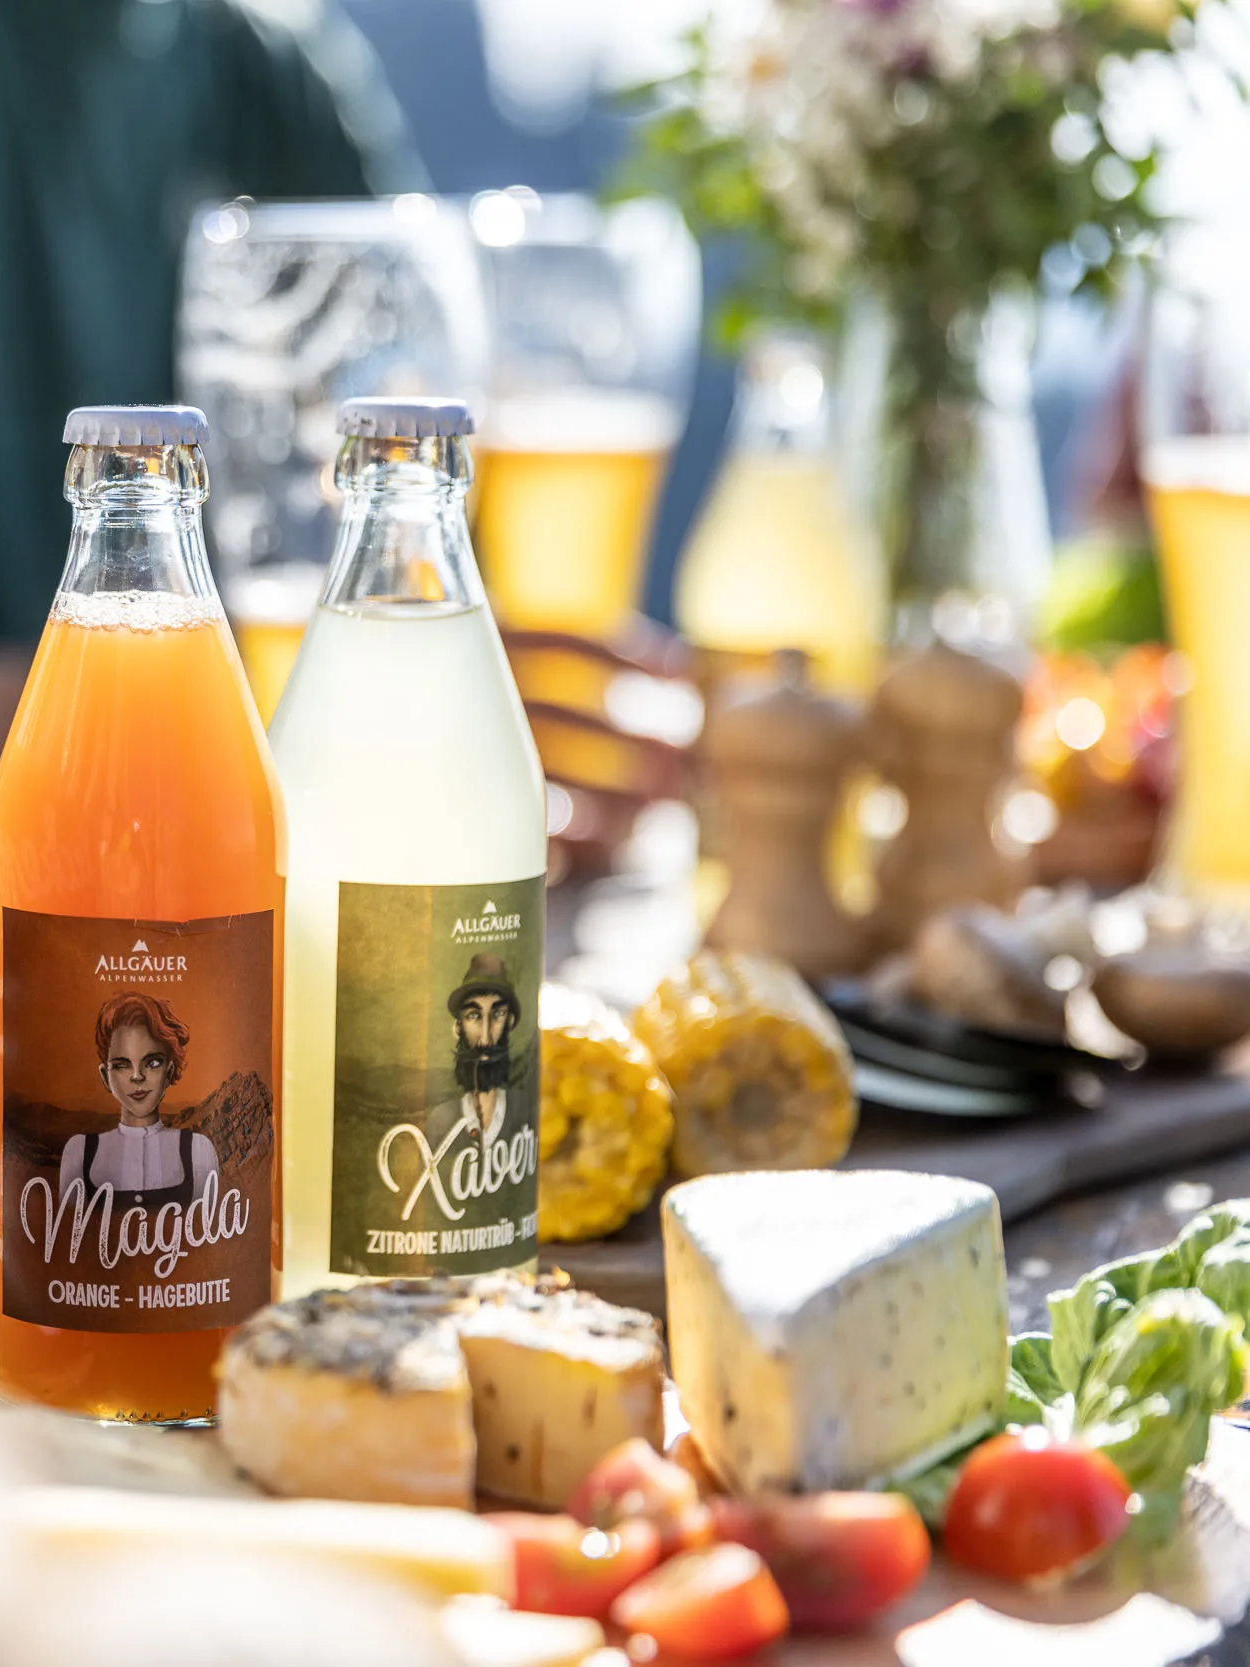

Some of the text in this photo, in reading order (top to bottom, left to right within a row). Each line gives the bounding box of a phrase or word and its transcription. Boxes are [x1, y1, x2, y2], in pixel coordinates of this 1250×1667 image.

[451, 913, 521, 938] ALLGÄUER
[94, 954, 188, 975] ALLGÄUER
[99, 974, 183, 983] ALPENWASSER
[20, 1169, 250, 1279] Magda
[366, 1229, 439, 1255] ZITRONE
[440, 1217, 515, 1254] NATURTRÜB
[48, 1280, 120, 1308] ORANGE
[138, 1278, 231, 1309] HAGEBUTTE
